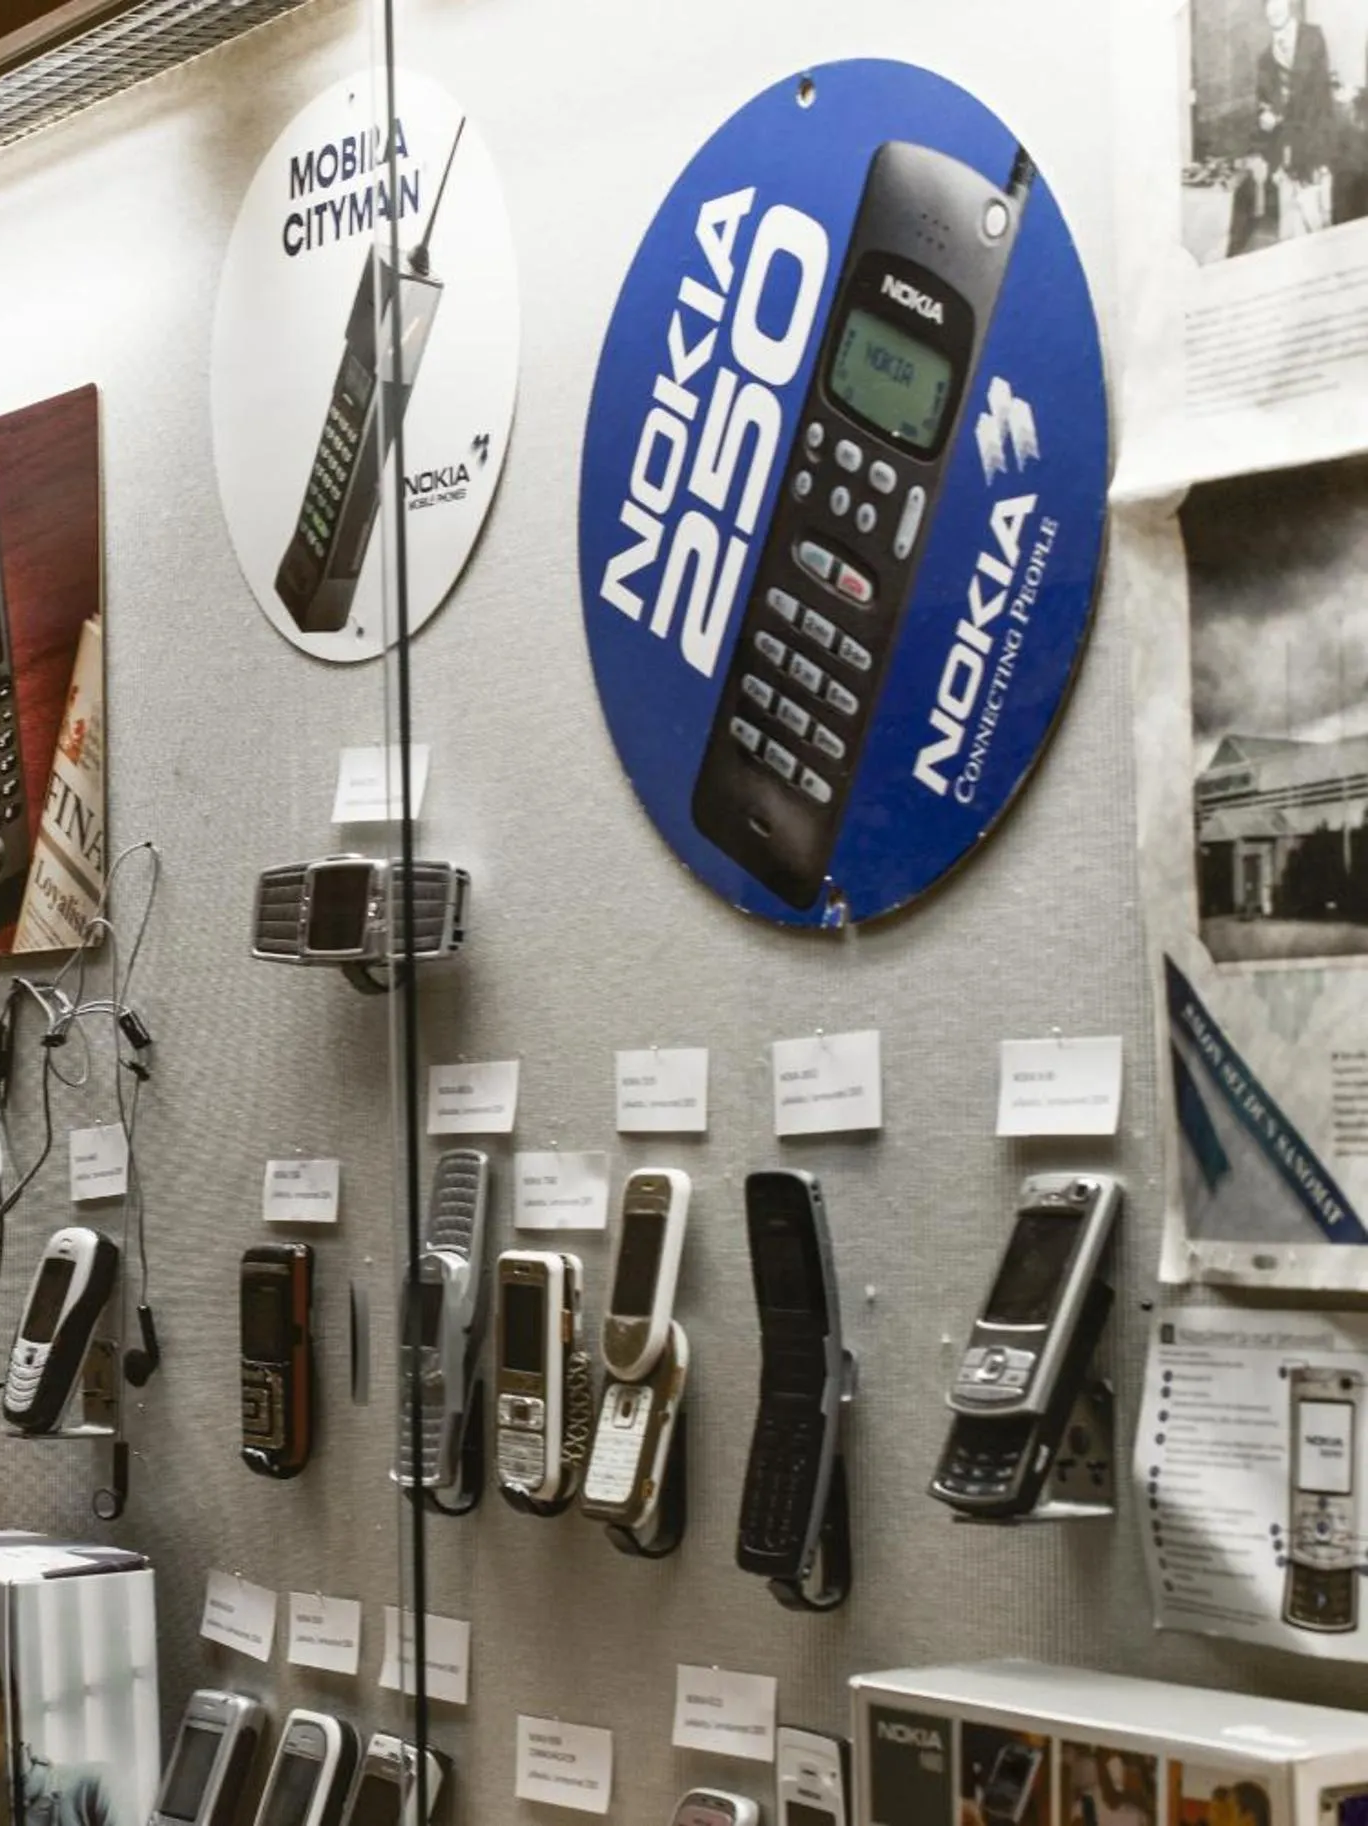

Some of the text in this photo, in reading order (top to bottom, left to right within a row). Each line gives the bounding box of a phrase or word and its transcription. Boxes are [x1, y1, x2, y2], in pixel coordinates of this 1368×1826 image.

[282, 168, 420, 257] CITYMAN
[880, 273, 944, 326] NOKIA
[403, 462, 471, 496] NOKIA
[599, 186, 758, 622] NOKIA
[649, 203, 830, 679] 250
[912, 494, 1038, 797] NOKIA
[953, 515, 1059, 804] CONNECTING PEOPLE
[877, 1720, 944, 1751] NOKIA
